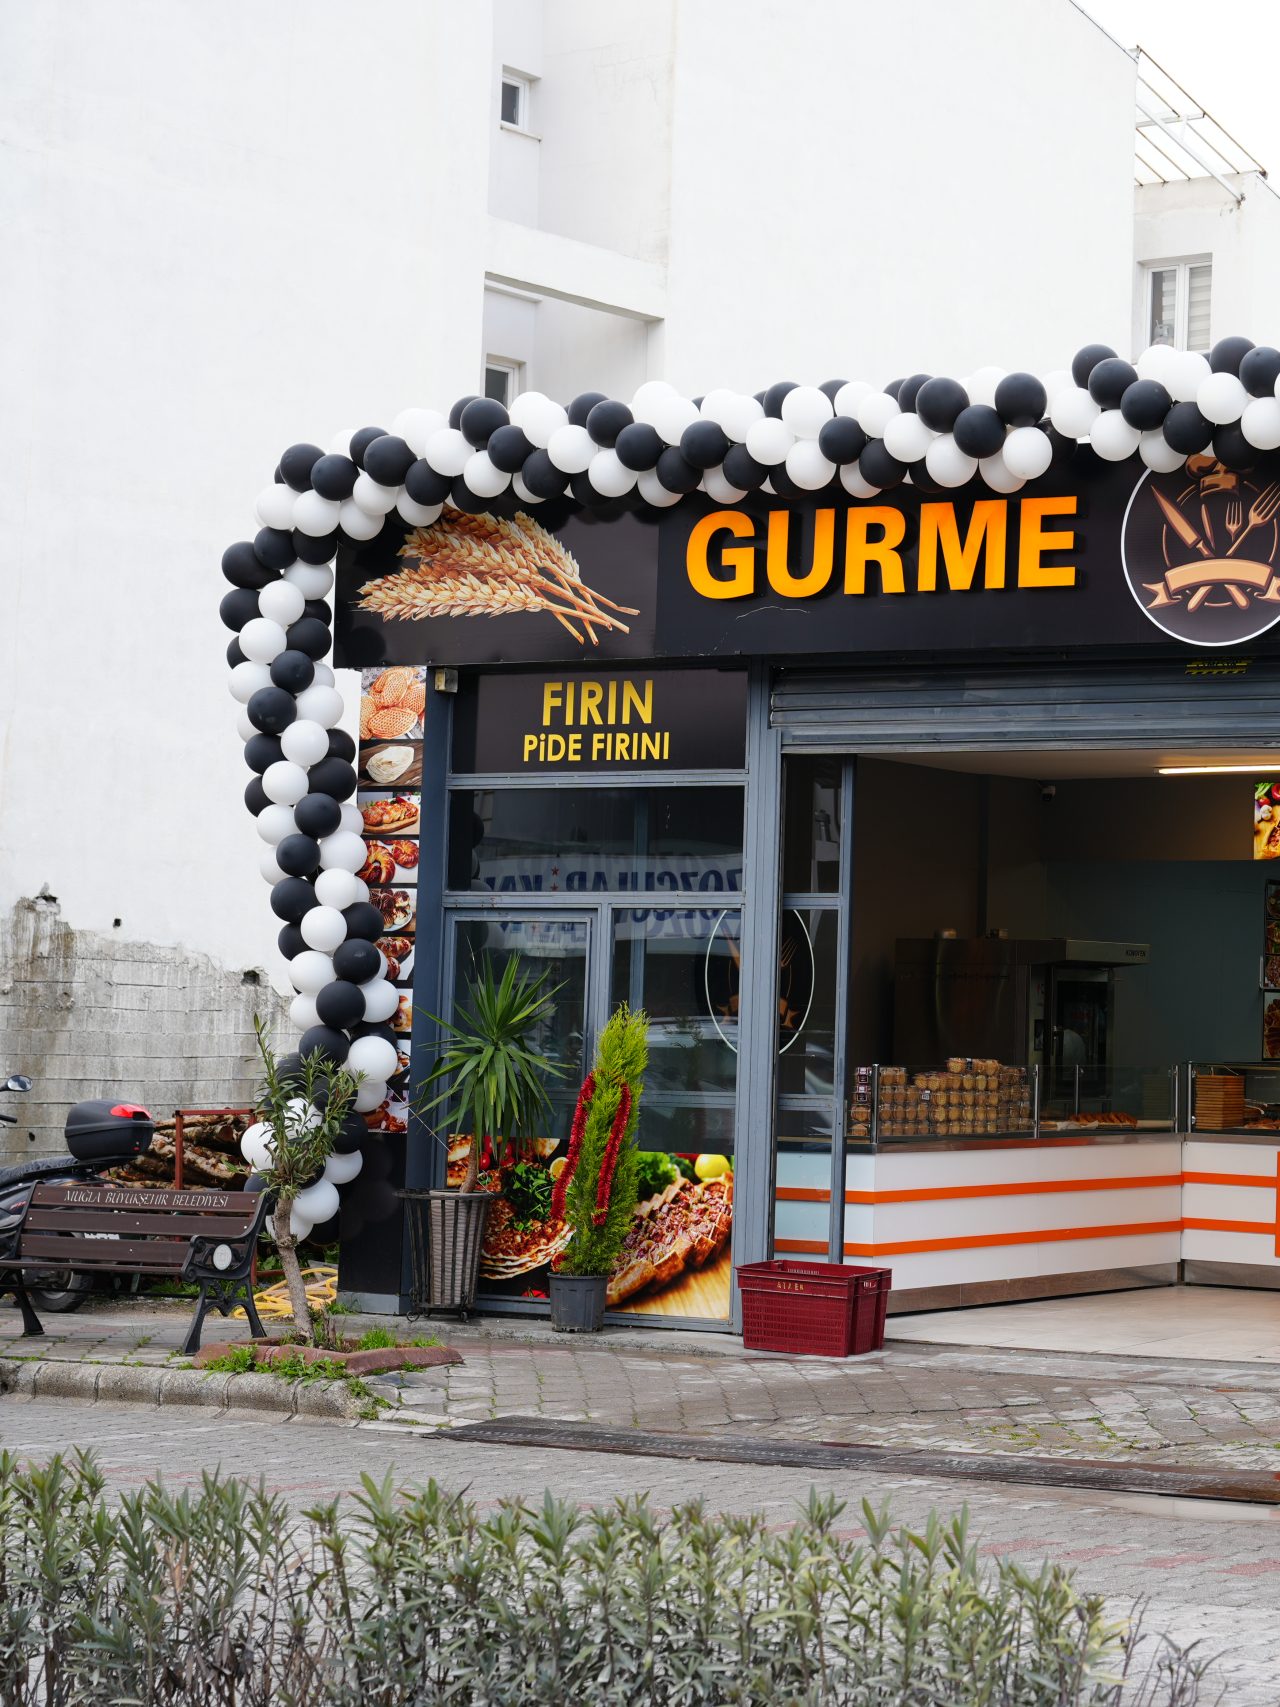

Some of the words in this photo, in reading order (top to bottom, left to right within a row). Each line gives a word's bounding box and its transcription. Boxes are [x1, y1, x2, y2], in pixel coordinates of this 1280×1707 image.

[686, 495, 1079, 600] GURME
[542, 680, 653, 727] FIRIN
[592, 732, 670, 761] FIRINI
[64, 1189, 101, 1203] MUĞLA
